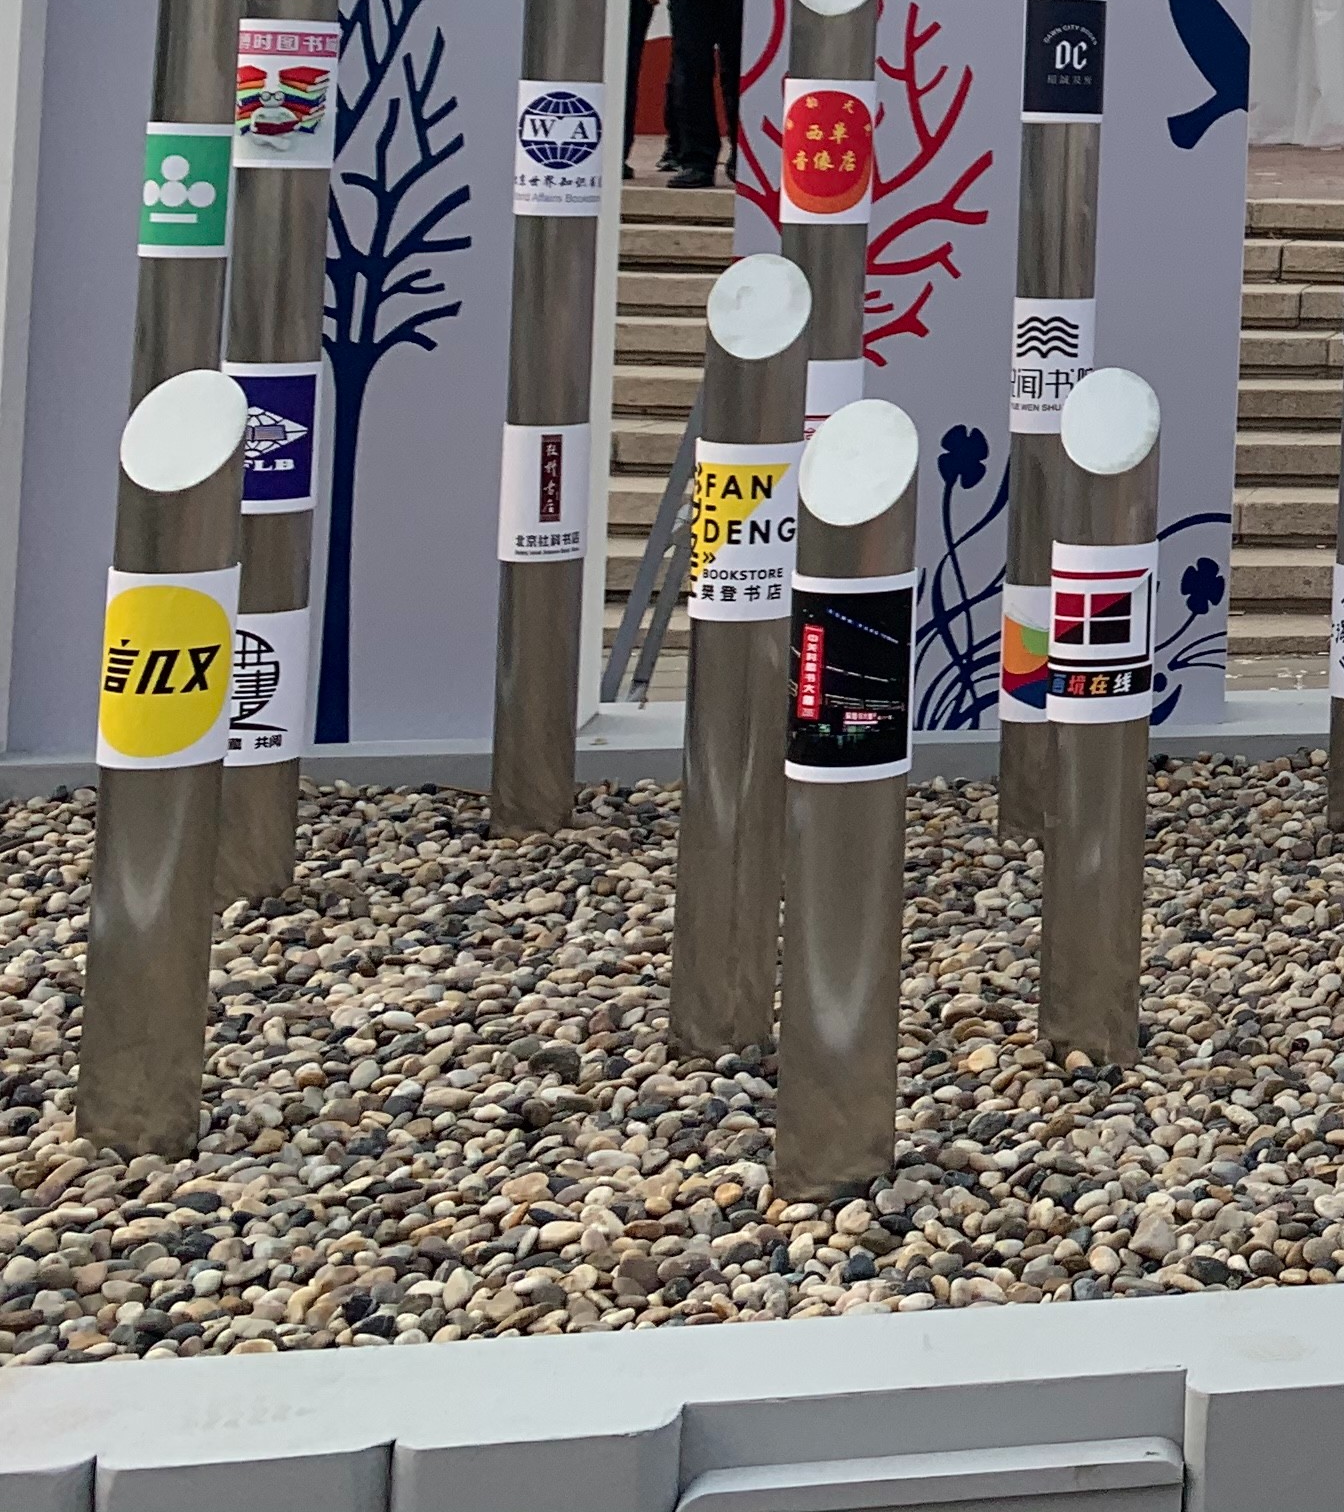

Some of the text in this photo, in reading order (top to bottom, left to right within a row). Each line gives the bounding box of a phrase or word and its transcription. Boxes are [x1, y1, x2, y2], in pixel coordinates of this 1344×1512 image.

[529, 118, 590, 141] W A
[792, 151, 858, 174] 音像店
[1021, 402, 1040, 412] WEN
[1041, 402, 1062, 413] SHU
[705, 473, 774, 500] FAN
[704, 517, 797, 545] DENG
[702, 567, 784, 581] BOOKSTORE
